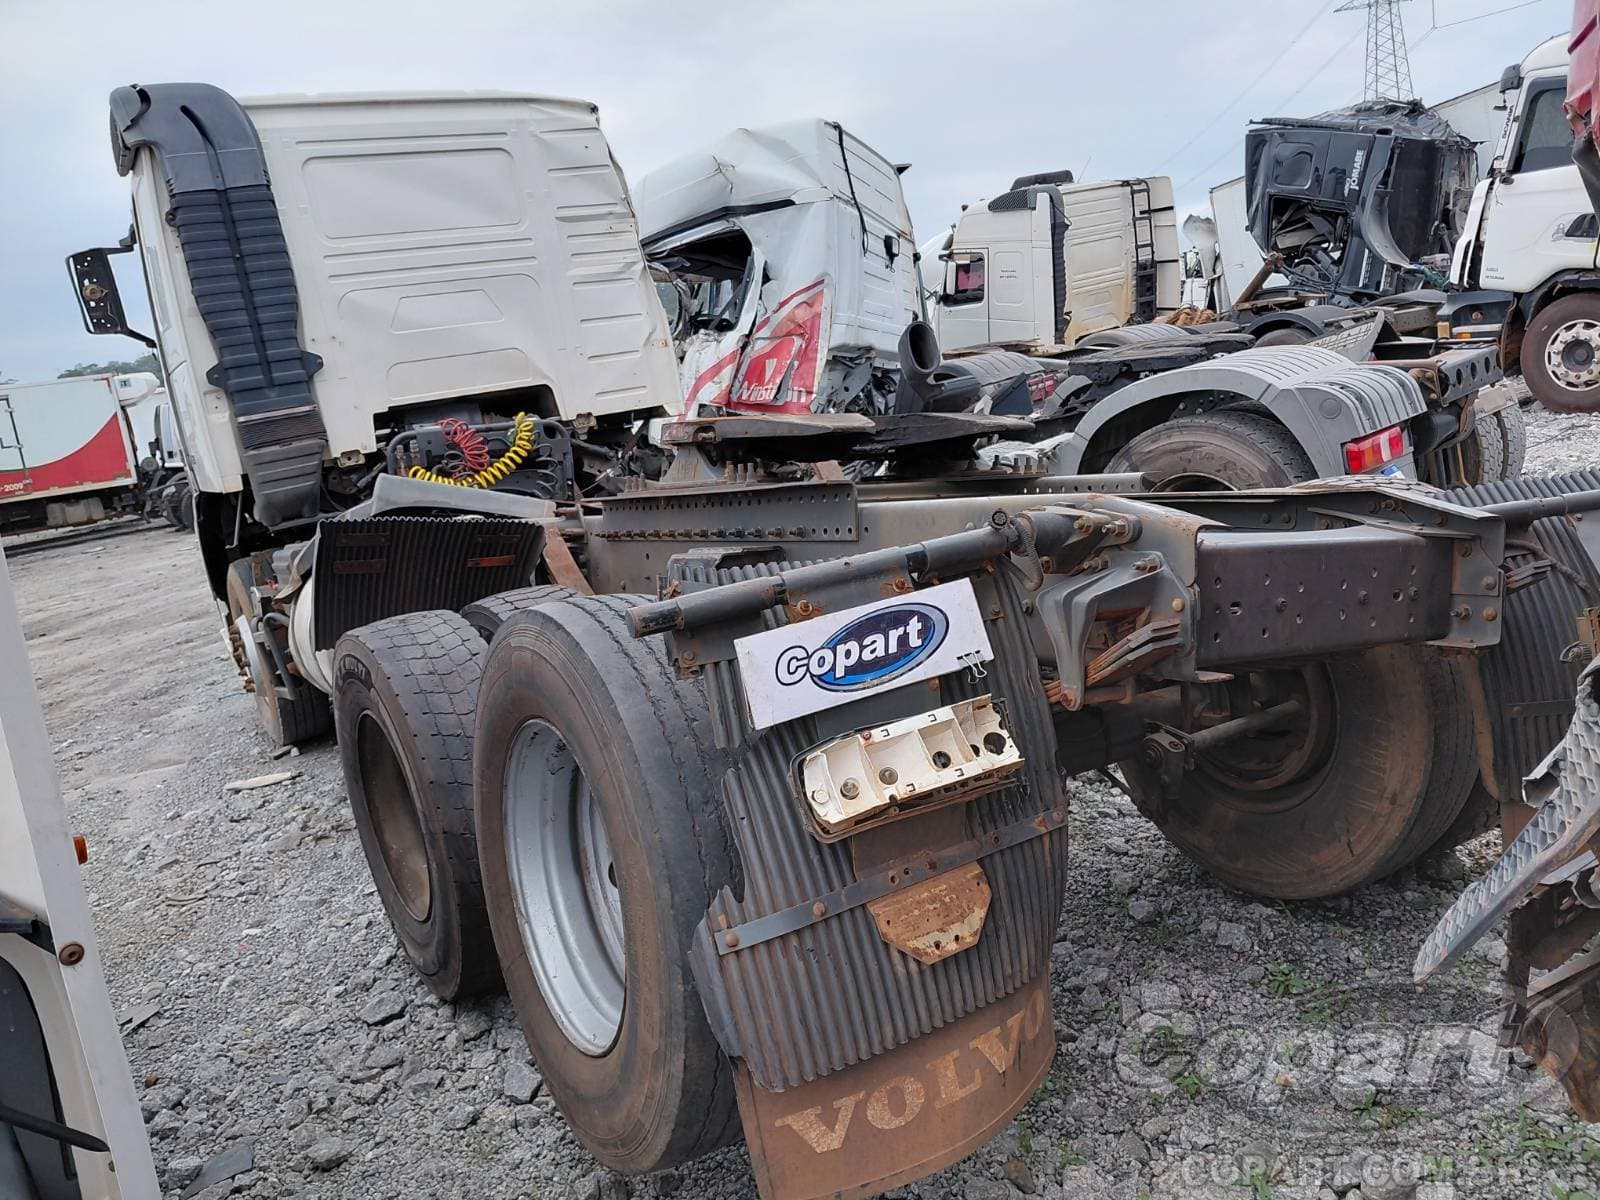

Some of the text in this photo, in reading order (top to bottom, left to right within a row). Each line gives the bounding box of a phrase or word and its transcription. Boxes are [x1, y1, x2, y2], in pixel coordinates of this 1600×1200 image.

[1350, 149, 1364, 190] JOMABE
[775, 614, 923, 687] Copart
[774, 989, 1046, 1154] VOLVO
